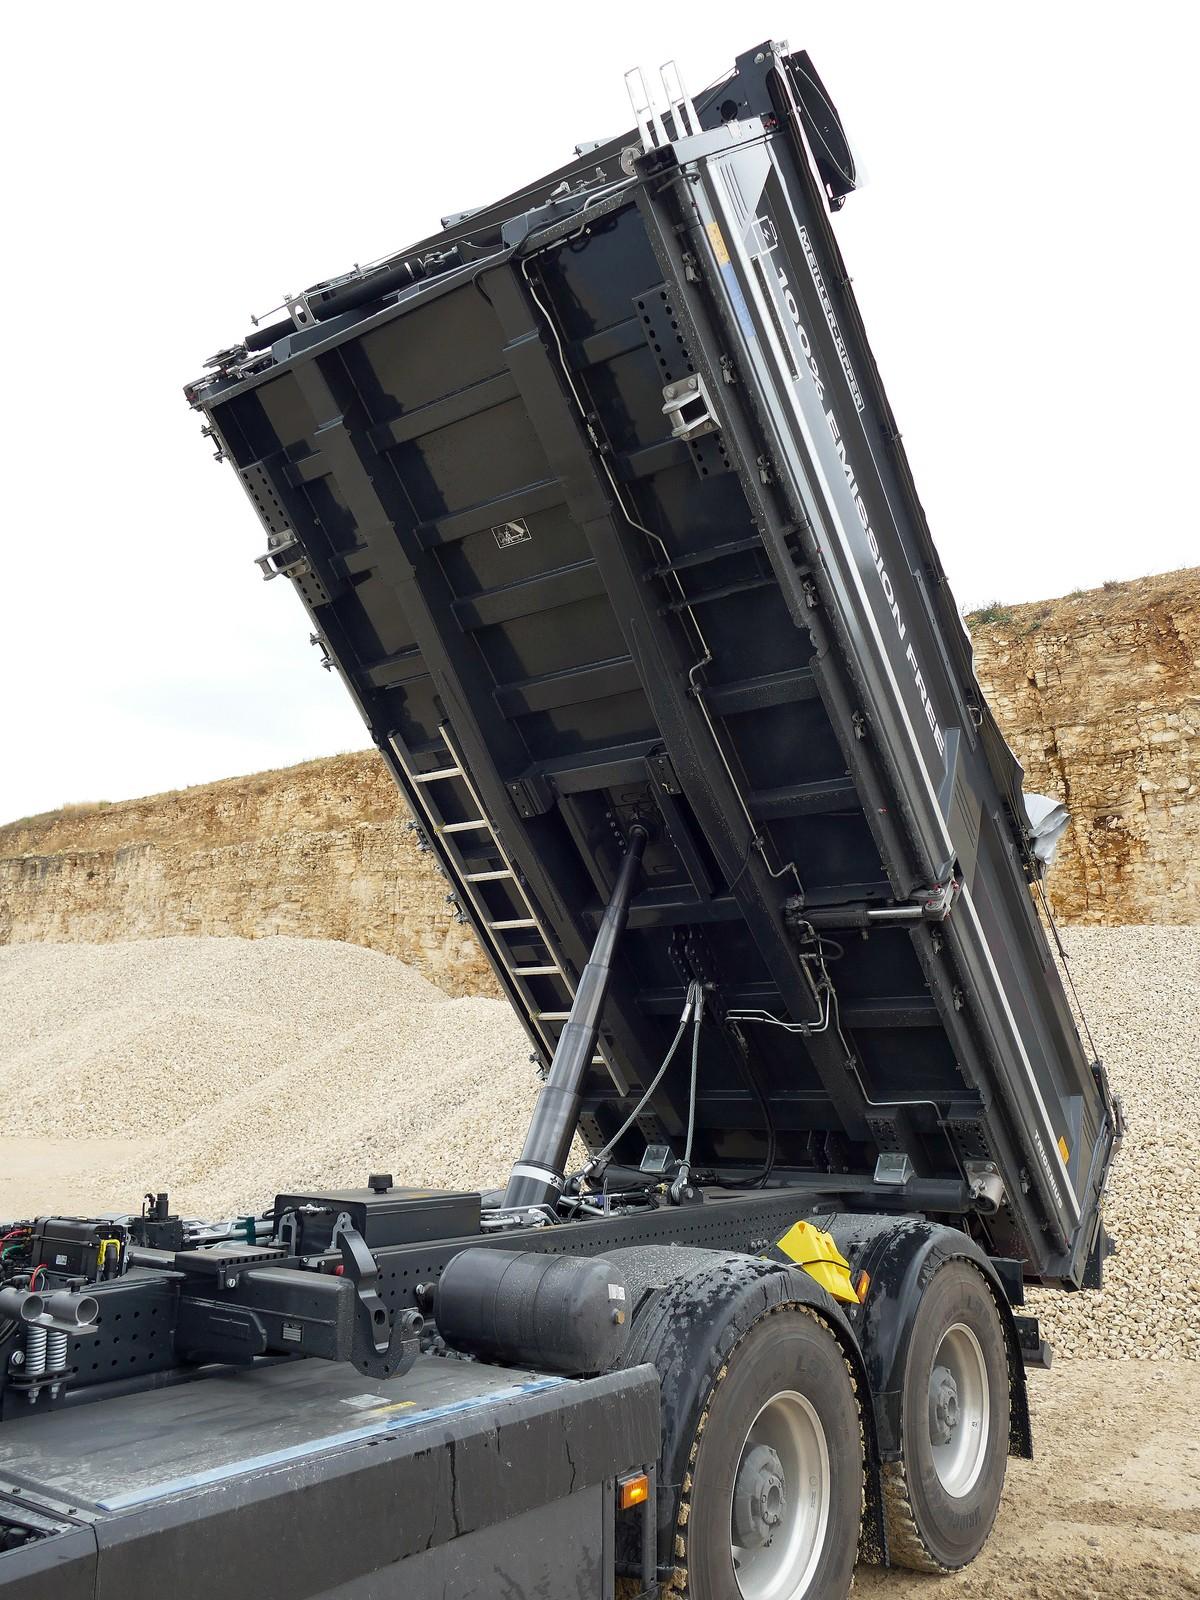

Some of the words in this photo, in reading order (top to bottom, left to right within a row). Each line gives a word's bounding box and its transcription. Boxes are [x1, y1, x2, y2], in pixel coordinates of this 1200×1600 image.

[801, 230, 863, 408] MEILLER-KIPPER
[777, 267, 825, 400] 100%
[826, 409, 906, 640] EMISSION
[906, 643, 945, 756] FREE
